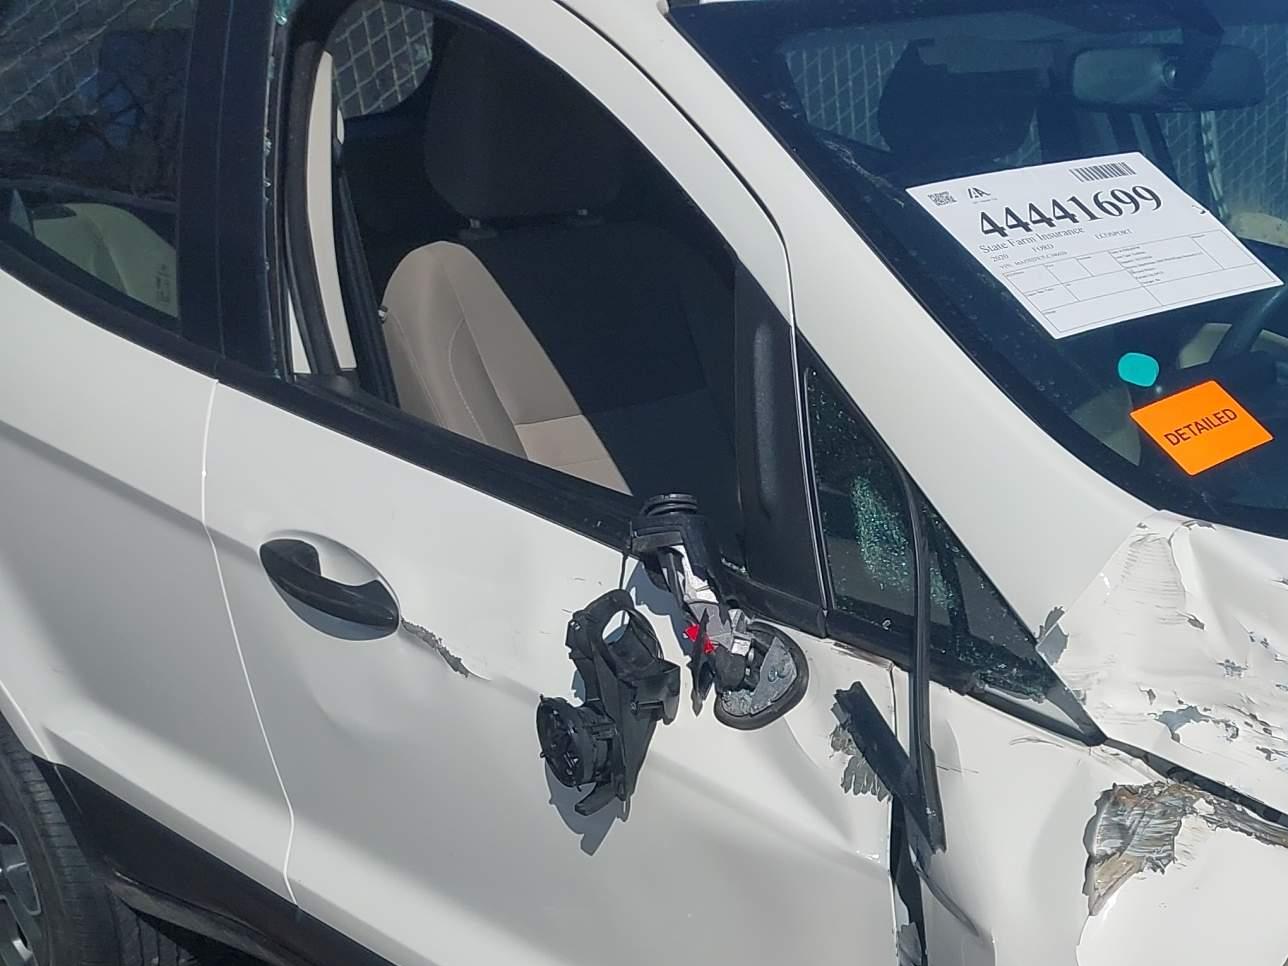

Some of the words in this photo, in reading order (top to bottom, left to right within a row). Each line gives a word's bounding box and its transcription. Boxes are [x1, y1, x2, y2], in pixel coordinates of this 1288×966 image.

[979, 185, 1163, 238] 44441699
[979, 241, 1009, 254] State
[1007, 234, 1036, 248] Farm
[1034, 226, 1085, 241] Insurance
[1164, 408, 1238, 446] DETAILED
